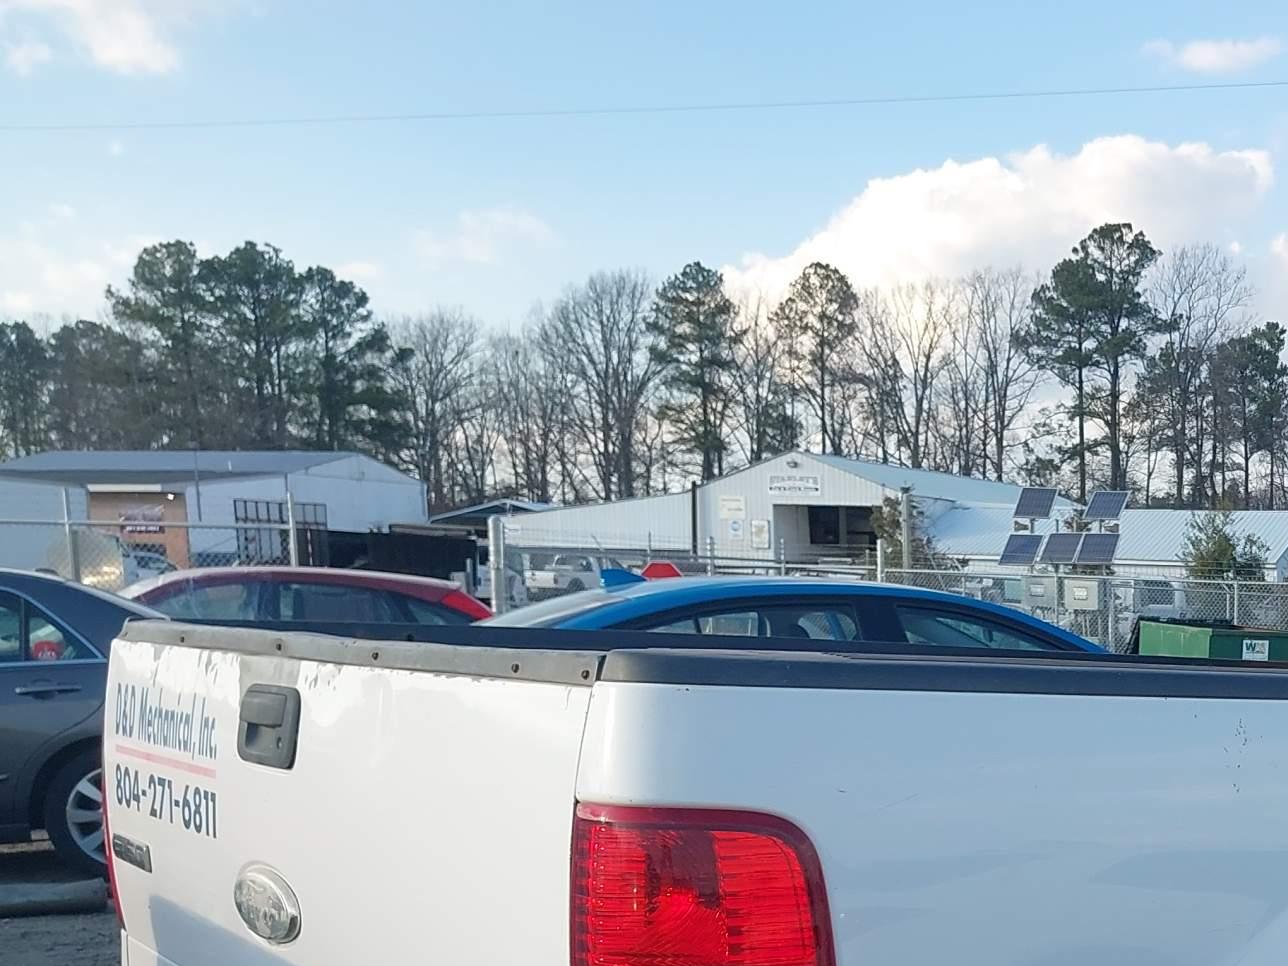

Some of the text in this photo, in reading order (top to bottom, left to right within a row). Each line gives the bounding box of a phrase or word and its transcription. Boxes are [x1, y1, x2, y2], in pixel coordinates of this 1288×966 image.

[115, 682, 217, 760] D&D Mechanical, Inc.
[115, 763, 217, 838] 804-271-6811
